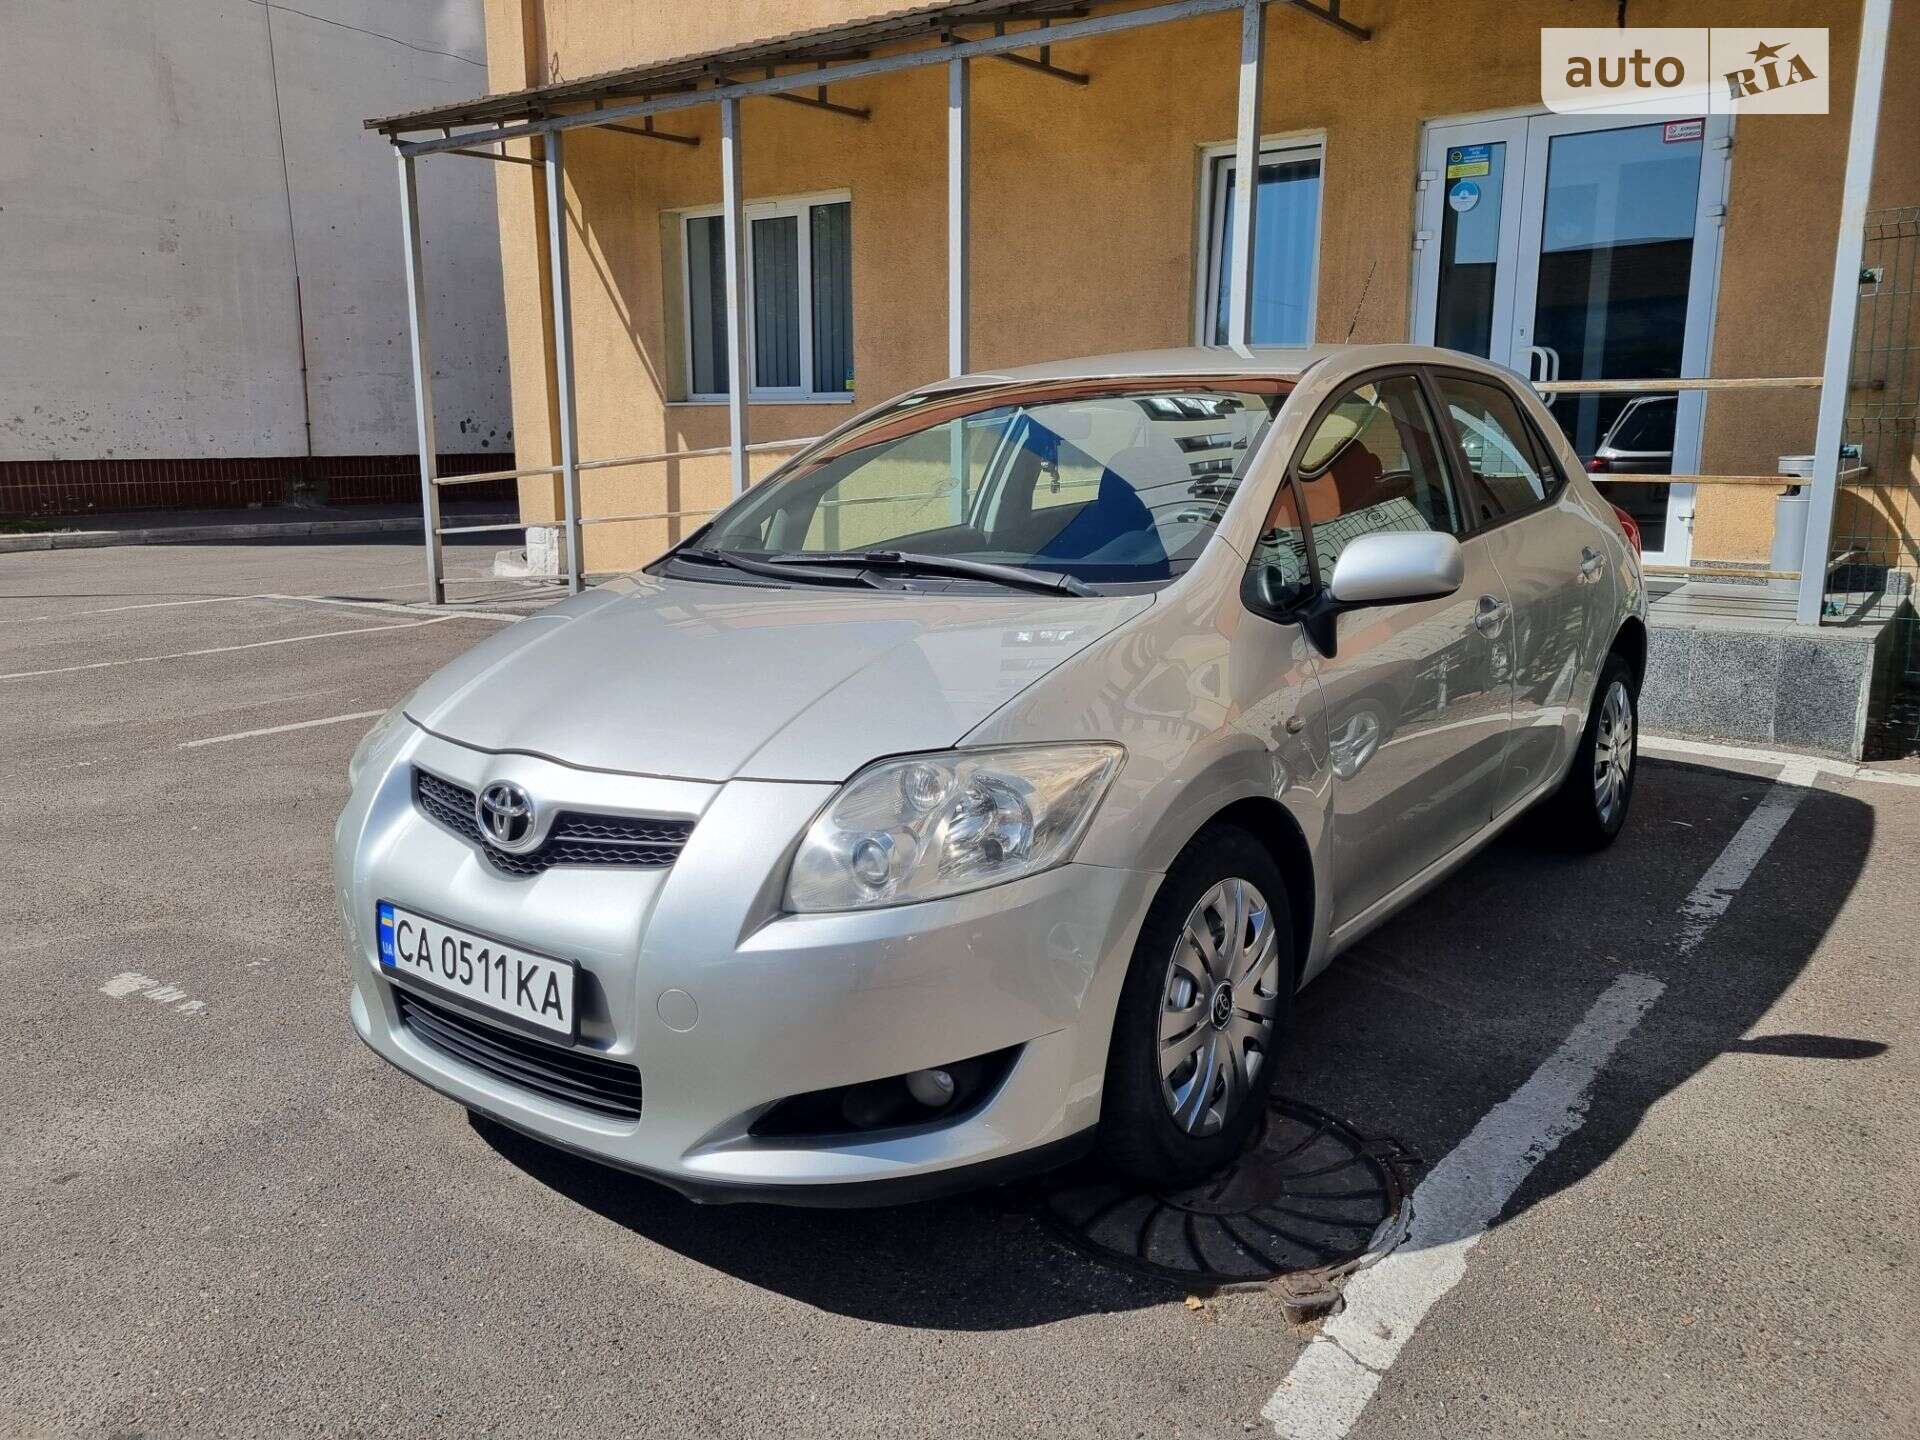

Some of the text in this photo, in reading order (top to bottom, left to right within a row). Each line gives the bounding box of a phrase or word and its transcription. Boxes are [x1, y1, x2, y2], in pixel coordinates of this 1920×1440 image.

[382, 940, 394, 955] UA
[397, 919, 564, 1021] CA 0511 KA
